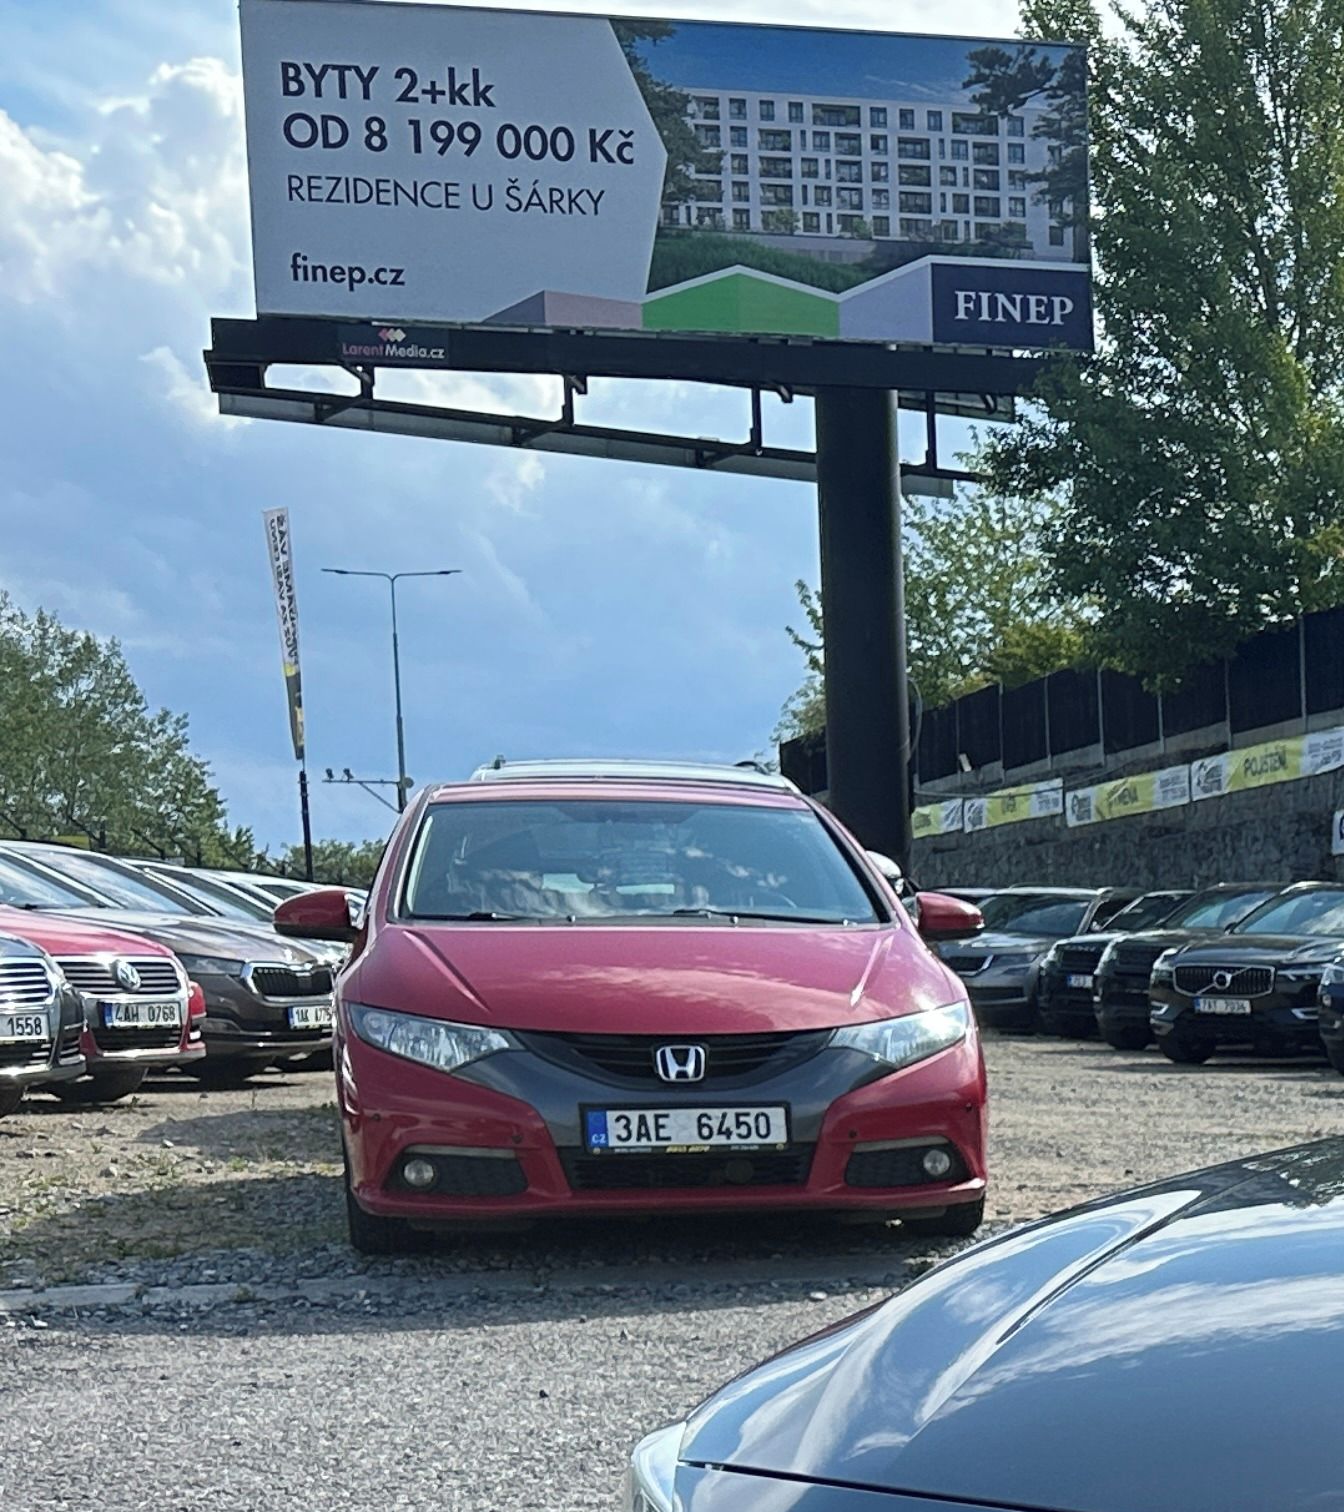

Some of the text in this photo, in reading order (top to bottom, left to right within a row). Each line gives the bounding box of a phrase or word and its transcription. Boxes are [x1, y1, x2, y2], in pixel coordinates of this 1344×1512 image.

[280, 61, 496, 108] BYTY 2+kk
[282, 112, 635, 165] OD 8 199 000 Kč
[287, 174, 606, 216] REZIDENCE U ŠÁRKY
[290, 252, 406, 292] finep.cz
[954, 290, 1074, 325] FINEP
[342, 343, 445, 359] LarentMedia.cz
[8, 1016, 43, 1037] 1558
[114, 1002, 140, 1021] 4AH
[614, 1112, 771, 1142] 3AE 6450
